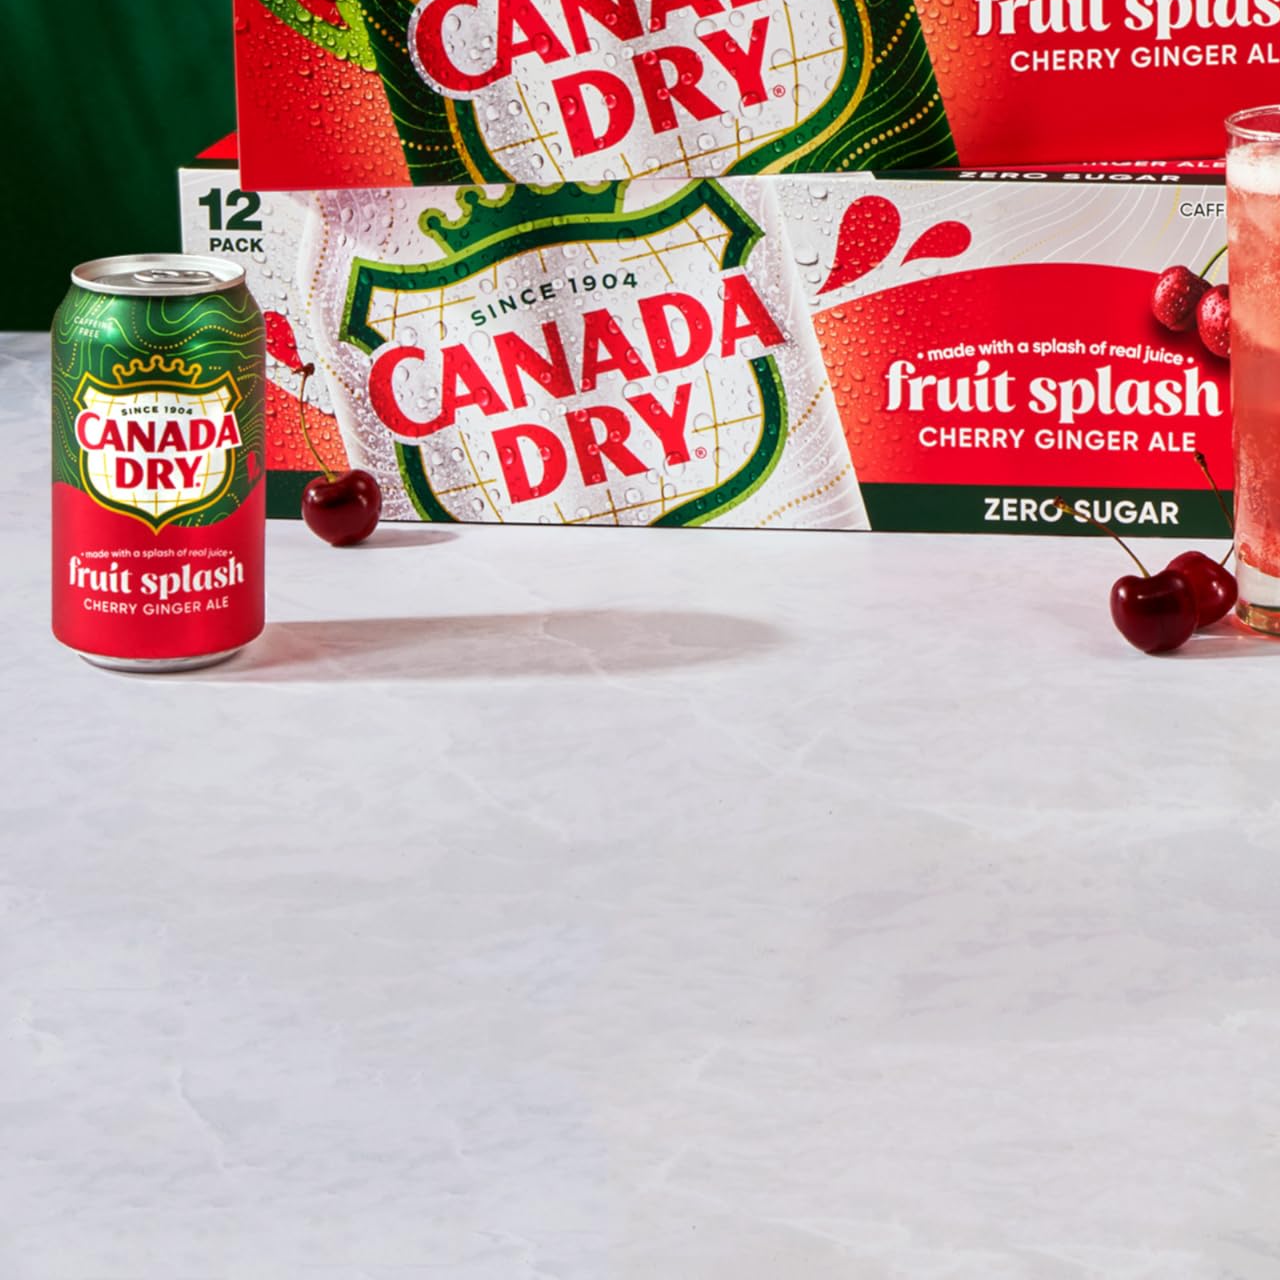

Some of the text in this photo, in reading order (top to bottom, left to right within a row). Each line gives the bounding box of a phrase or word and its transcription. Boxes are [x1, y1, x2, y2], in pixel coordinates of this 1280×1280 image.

[1010, 48, 1121, 72] CHERRY
[1130, 44, 1237, 68] GINGER
[958, 171, 1182, 182] ZERO SUGAR
[199, 188, 262, 231] 12
[1180, 203, 1225, 217] CAFF
[209, 238, 264, 253] PACK
[470, 271, 638, 326] SINCE 1904
[74, 316, 114, 330] CAFFEINE
[78, 327, 99, 338] FREE
[368, 273, 787, 439] CANADA
[927, 338, 1184, 366] made with a splash of real juice
[885, 359, 1223, 424] fruit splash
[121, 405, 193, 416] SINCE 1904
[77, 412, 240, 453] CANADA
[918, 426, 1196, 453] CHERRY GINGER ALE
[984, 497, 1180, 524] ZERO SUGAR
[85, 549, 109, 558] made
[111, 549, 132, 558] with
[142, 548, 175, 559] splash
[176, 548, 187, 557] of
[188, 548, 208, 557] real
[207, 548, 228, 559] juice
[69, 555, 245, 600] fruit splash
[83, 596, 229, 616] CHERRY GINGER ALE
